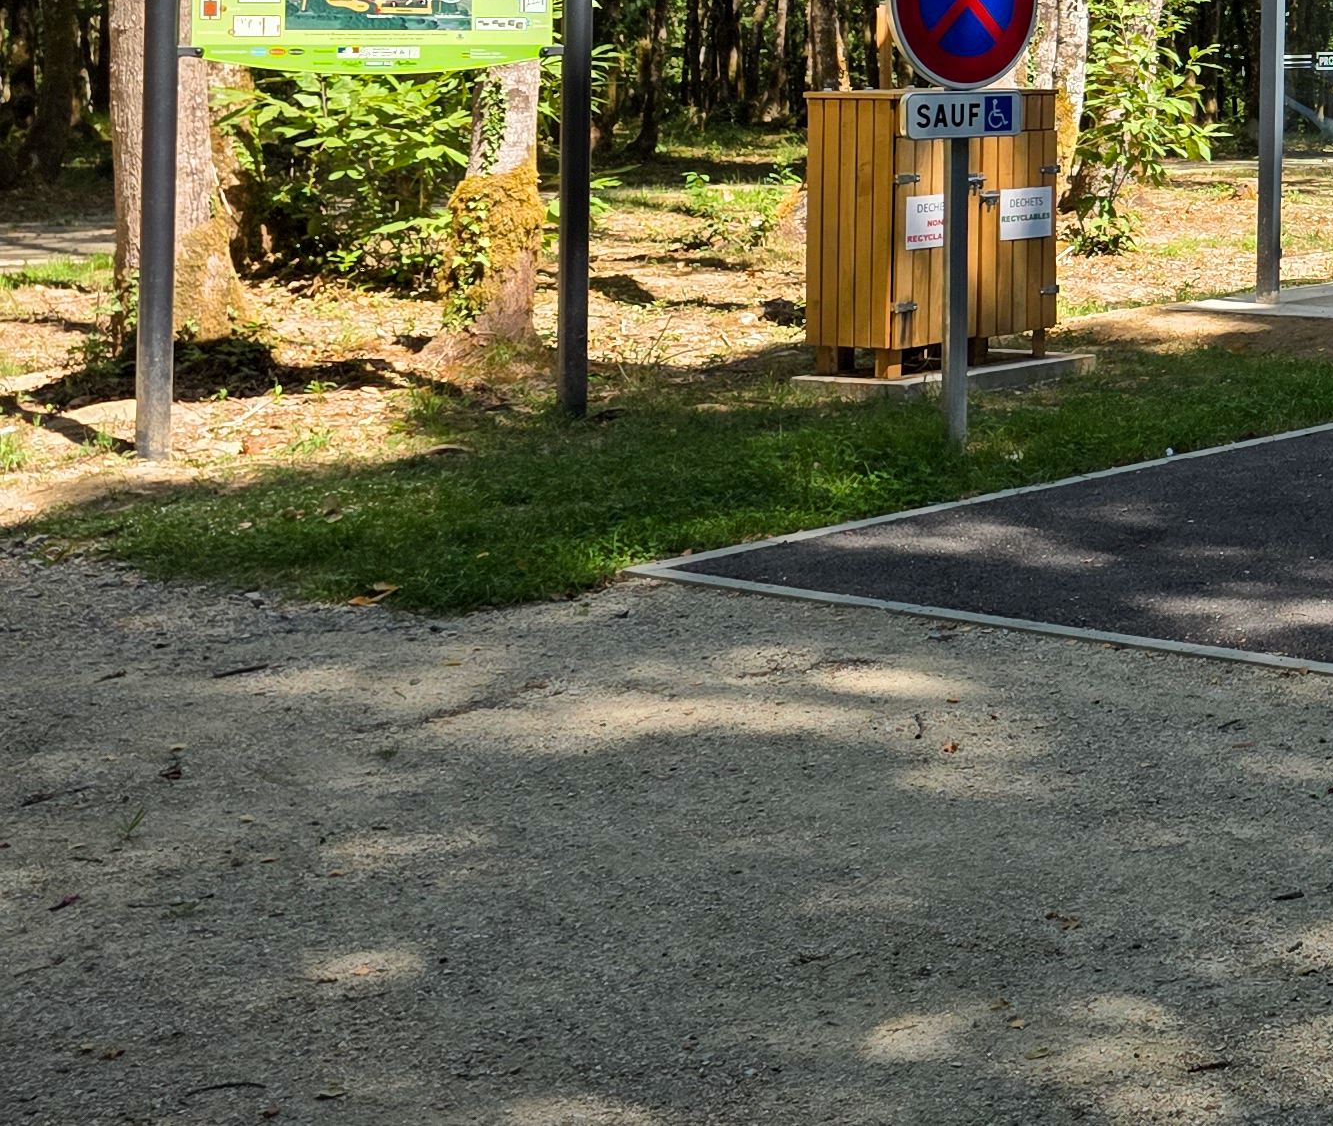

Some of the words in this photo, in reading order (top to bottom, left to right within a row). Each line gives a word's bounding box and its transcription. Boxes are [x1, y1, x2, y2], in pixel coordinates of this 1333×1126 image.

[916, 103, 981, 128] SAUF
[916, 202, 944, 214] DECHE
[1009, 196, 1044, 209] DECHETS
[927, 219, 944, 227] NON
[1001, 211, 1051, 223] RECYCLABLES
[907, 233, 943, 243] RECYCLA
